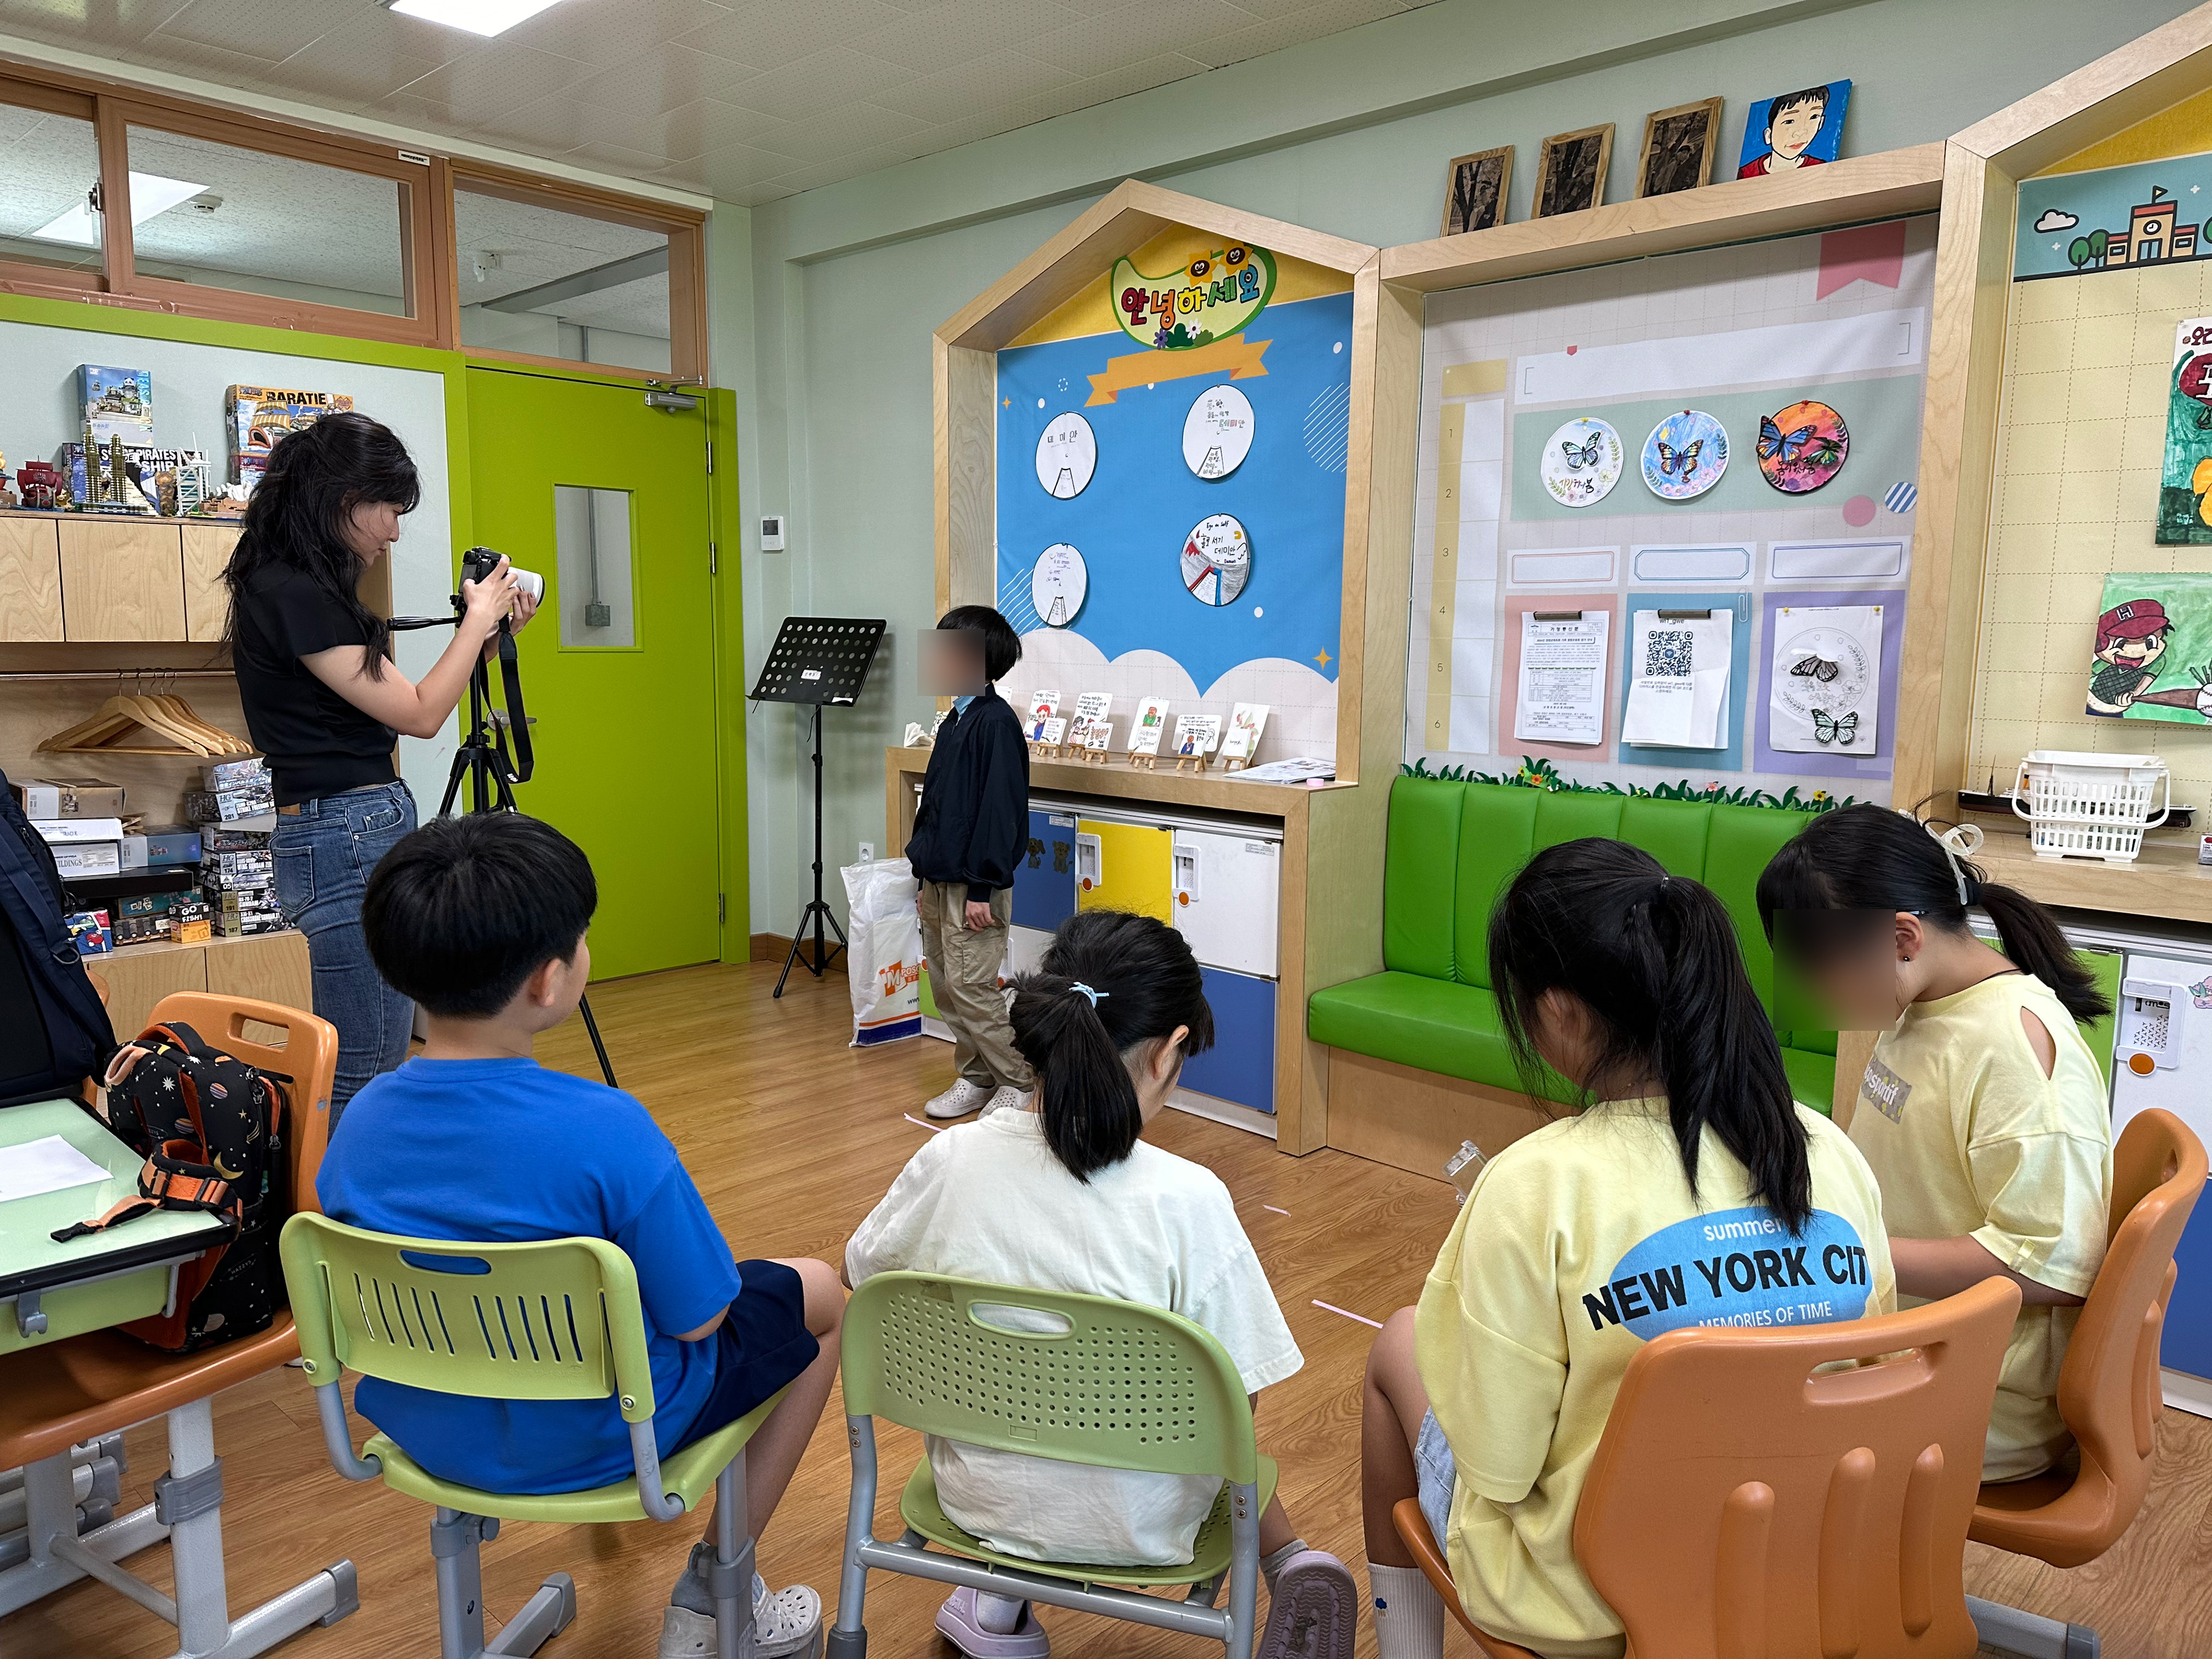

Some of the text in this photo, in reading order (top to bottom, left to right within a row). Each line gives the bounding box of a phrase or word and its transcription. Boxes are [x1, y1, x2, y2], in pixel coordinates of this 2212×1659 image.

[1121, 263, 1260, 331] 안녕하세요
[266, 391, 327, 405] BARATIE
[1449, 429, 1453, 438] 1
[137, 448, 177, 461] PIRATES
[141, 461, 174, 472] SHIP
[1445, 488, 1452, 498] 2
[1214, 546, 1236, 556] 데미안
[1442, 547, 1449, 558] 3
[1439, 605, 1445, 615] 4
[2116, 605, 2134, 622] H
[1437, 662, 1444, 672] 5
[1434, 719, 1441, 729] 6
[181, 906, 197, 915] GO
[182, 914, 203, 923] FISH!
[1703, 1217, 1782, 1242] summer
[1582, 1264, 1687, 1331] NEW
[1694, 1245, 1816, 1298] YORK
[1776, 1306, 1795, 1324] OF
[1800, 1301, 1834, 1320] TIME
